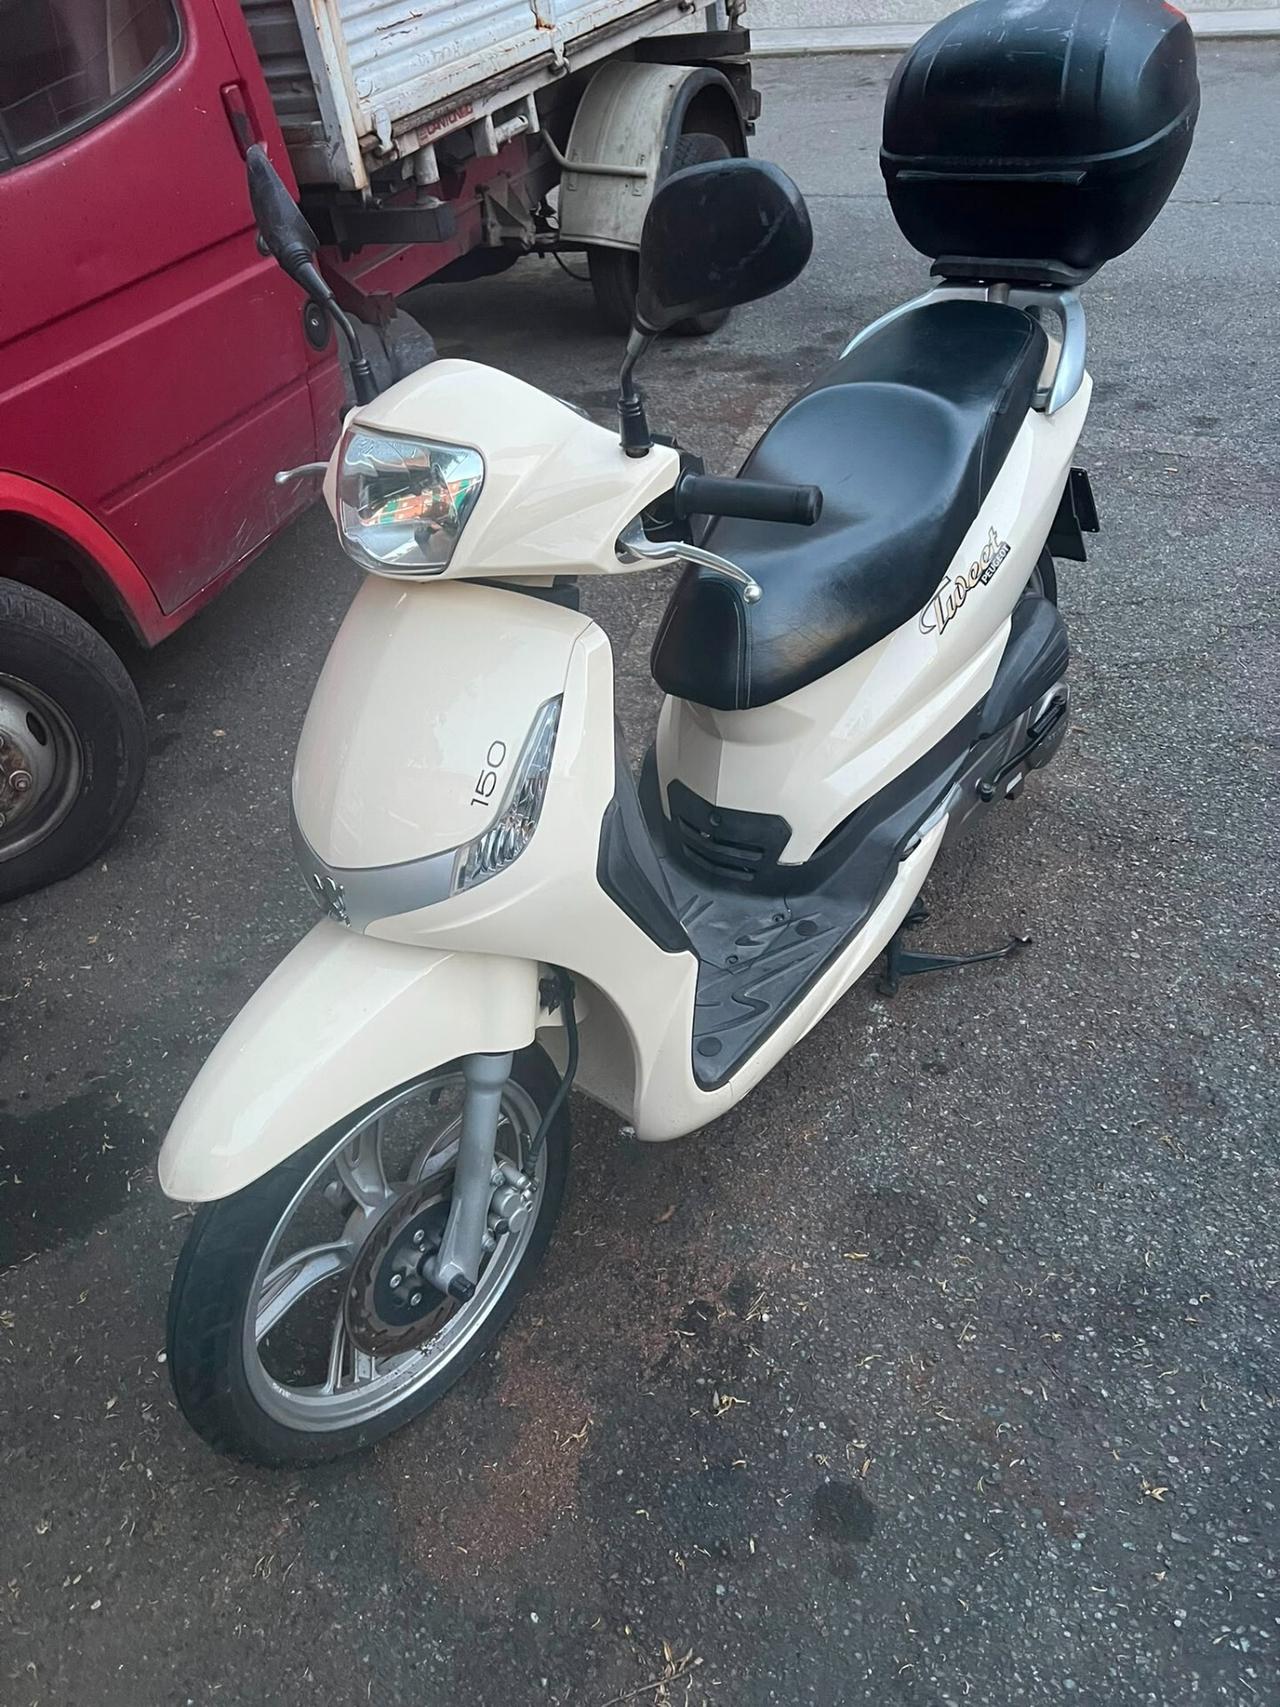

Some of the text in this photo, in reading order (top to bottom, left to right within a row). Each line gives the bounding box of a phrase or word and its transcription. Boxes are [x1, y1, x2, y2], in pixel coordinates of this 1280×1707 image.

[919, 526, 1000, 635] Tweet
[981, 543, 1011, 585] PEUGEOT
[470, 740, 506, 806] 150
